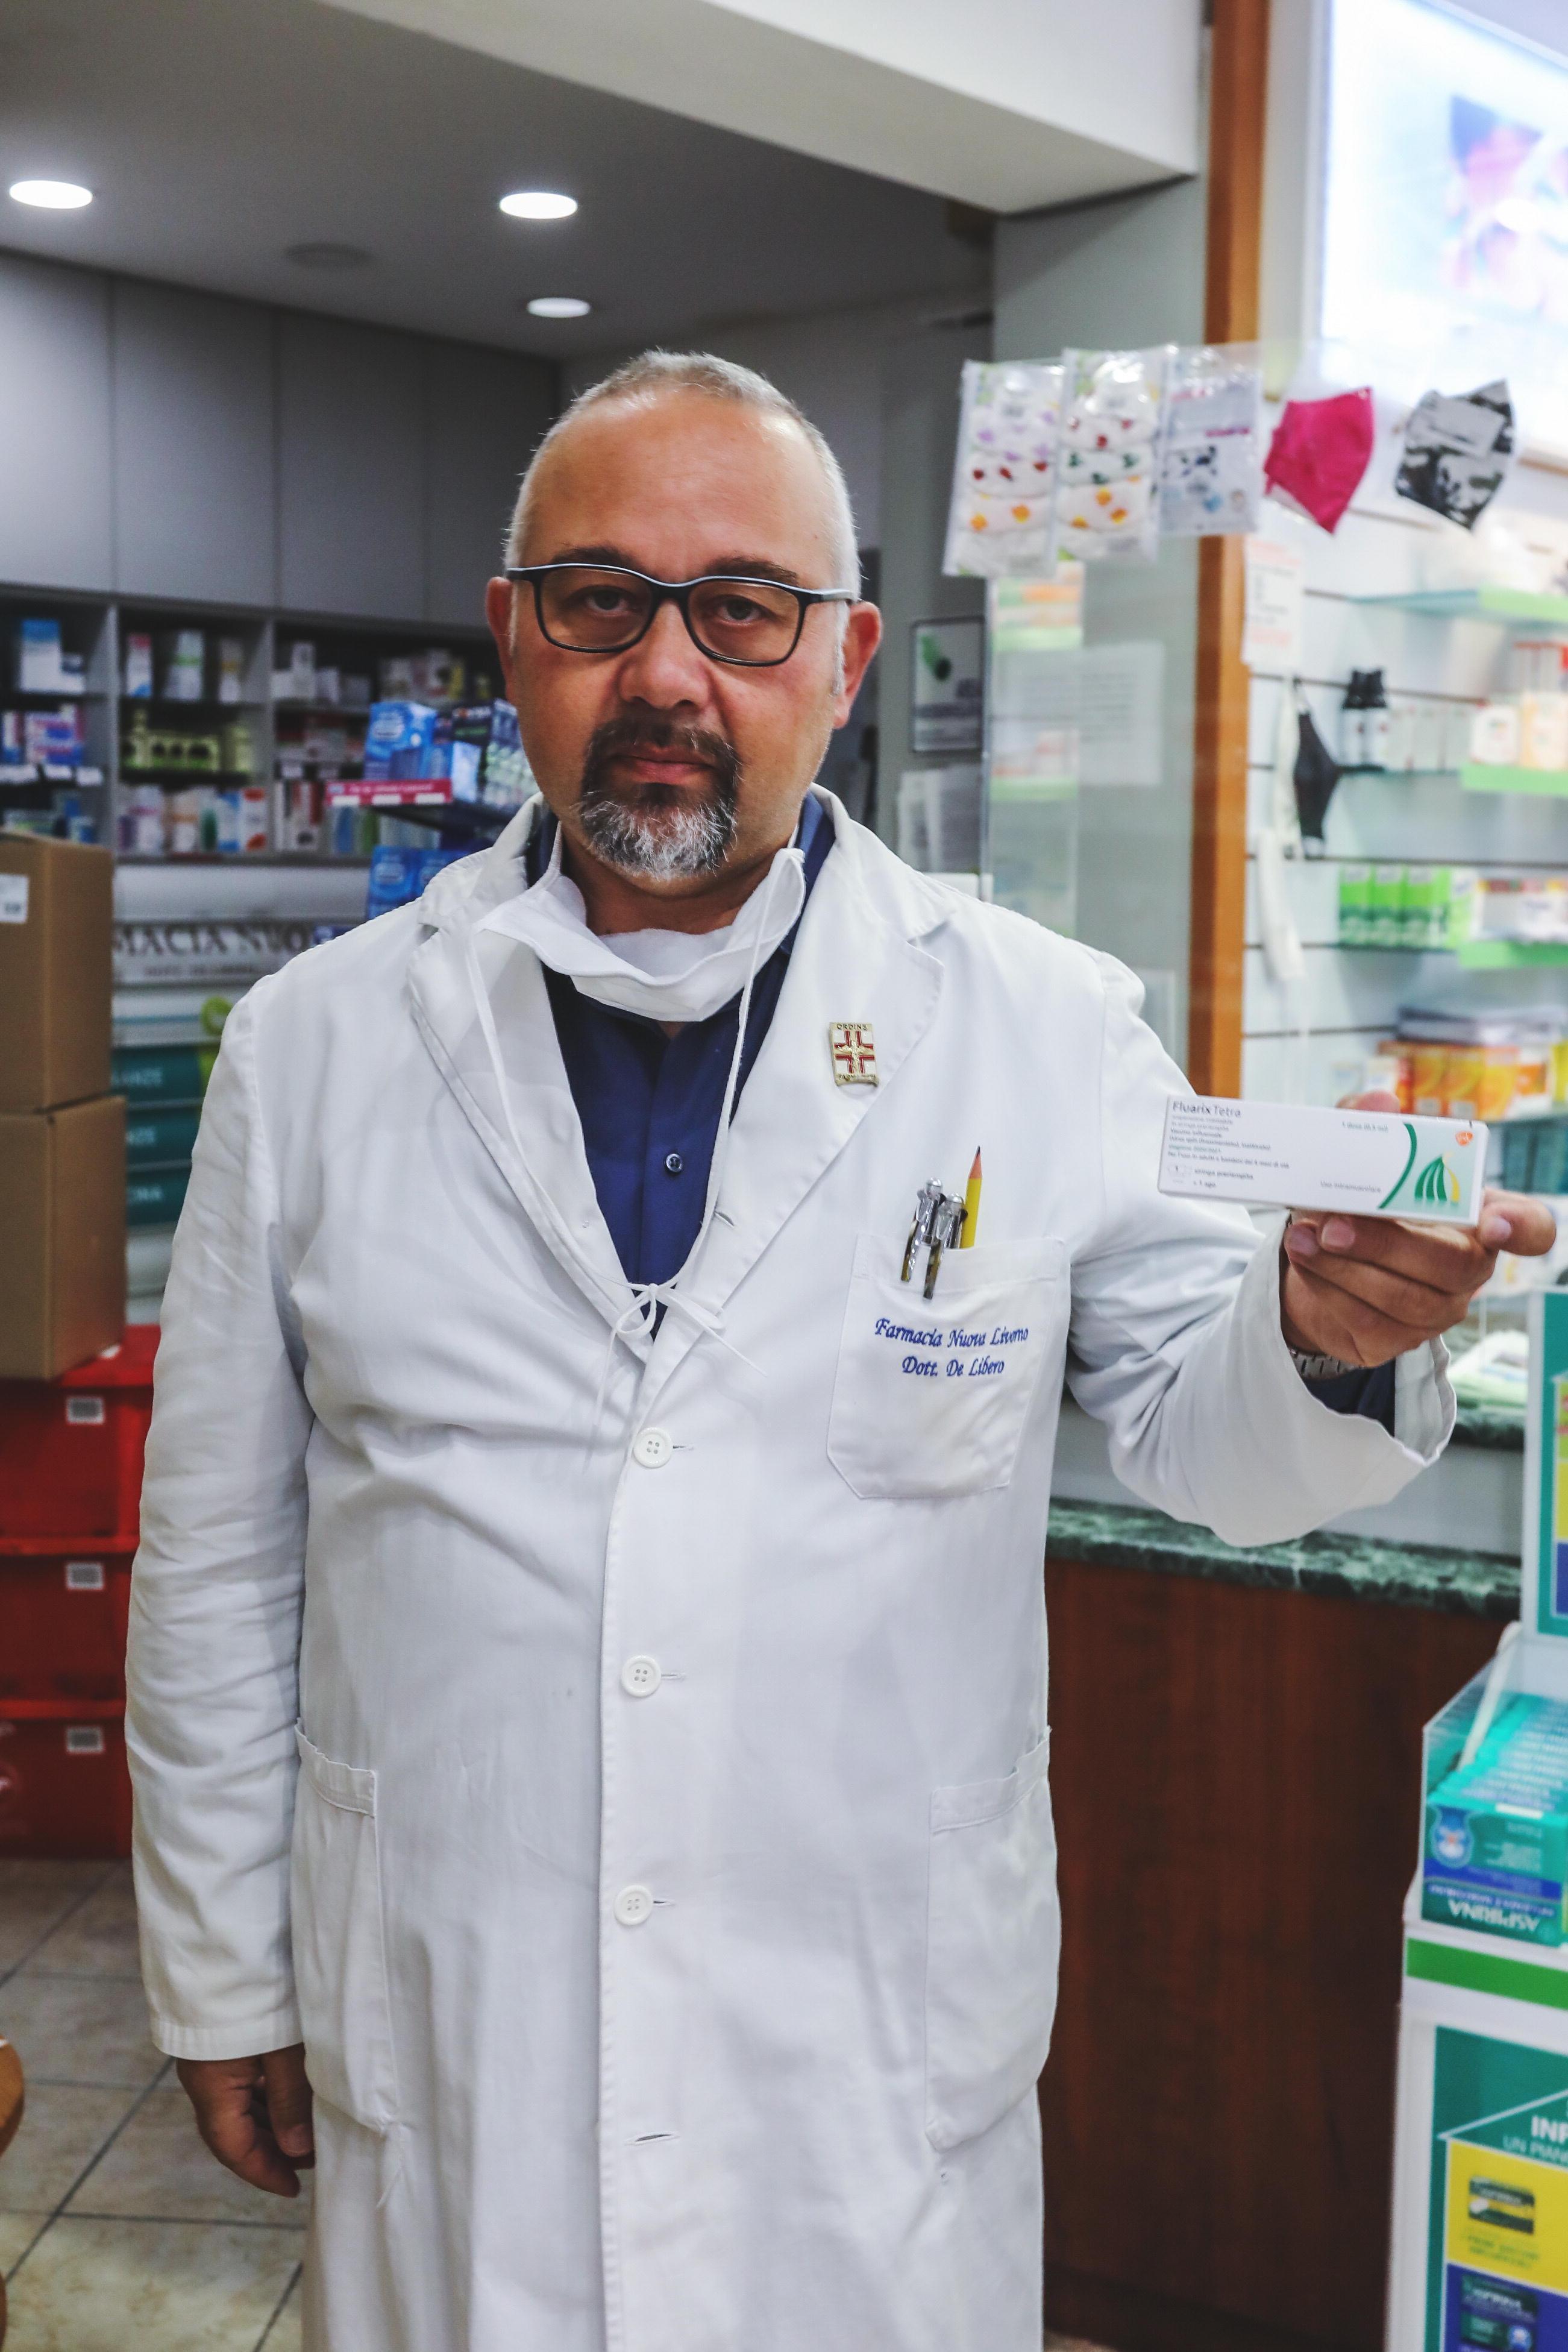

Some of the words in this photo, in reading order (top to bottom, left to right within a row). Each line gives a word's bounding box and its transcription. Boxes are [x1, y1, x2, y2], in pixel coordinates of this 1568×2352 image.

[1173, 1100, 1211, 1115] Fluarix
[1212, 1104, 1241, 1118] Tetra
[874, 1318, 942, 1347] Farmacia
[947, 1329, 985, 1348] Nuova
[902, 1355, 938, 1376] Dott.
[946, 1359, 964, 1377] De
[968, 1356, 1005, 1376] Libero
